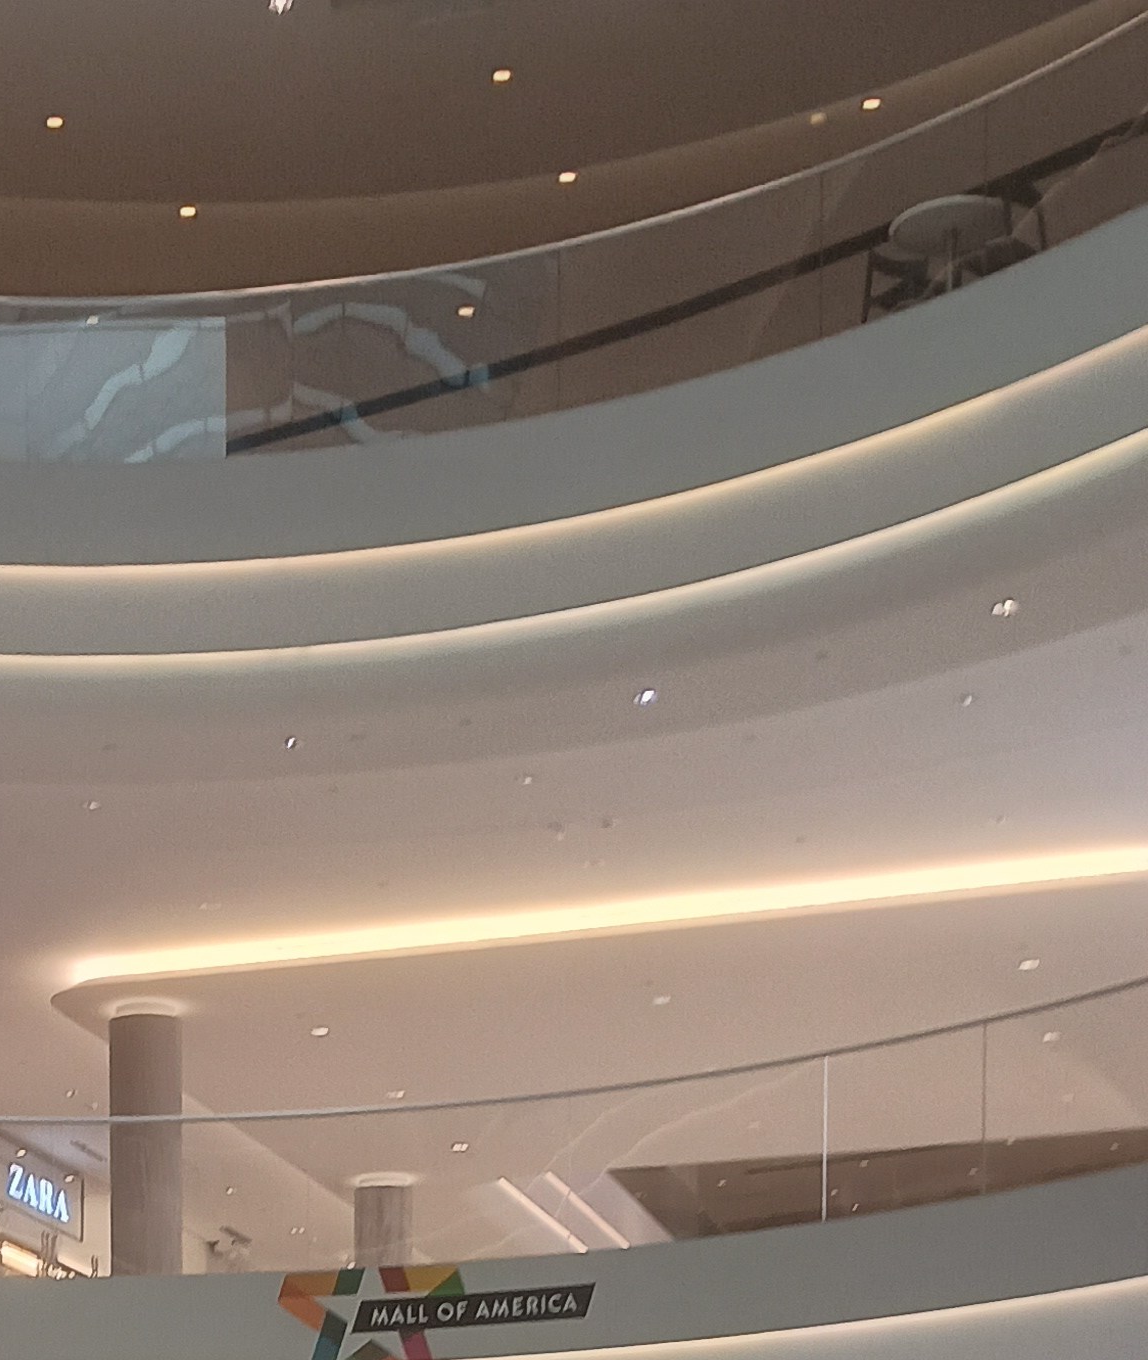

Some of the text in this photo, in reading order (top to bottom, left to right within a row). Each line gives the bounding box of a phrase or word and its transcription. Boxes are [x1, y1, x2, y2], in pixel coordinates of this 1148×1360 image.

[9, 1163, 69, 1223] ZARA
[370, 1293, 577, 1327] MALL OF AMERICA
